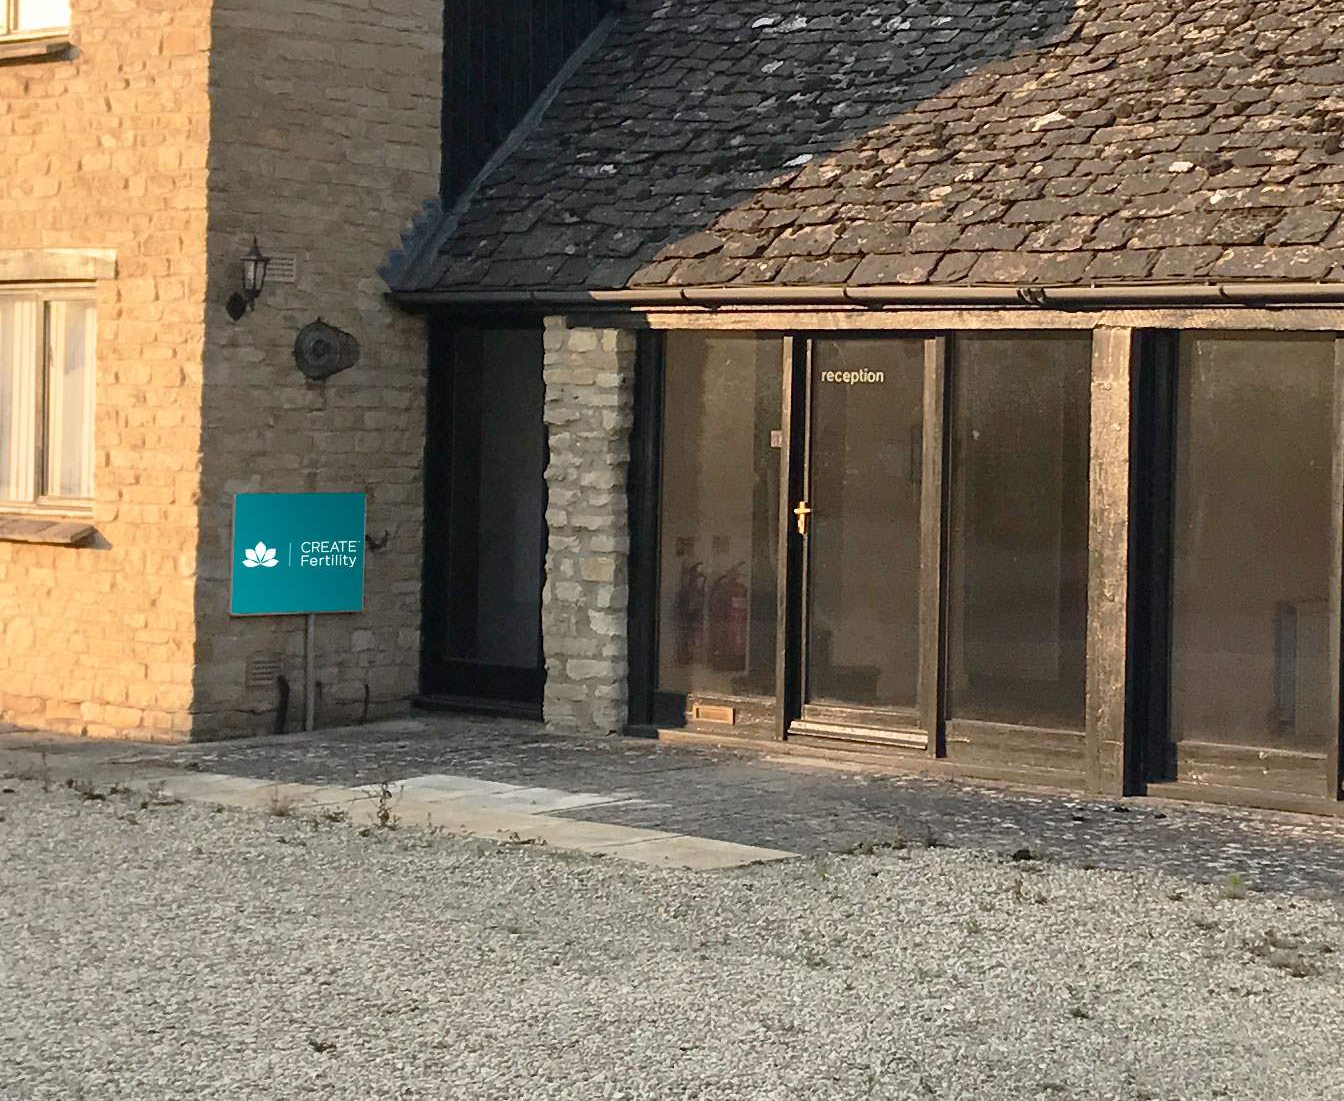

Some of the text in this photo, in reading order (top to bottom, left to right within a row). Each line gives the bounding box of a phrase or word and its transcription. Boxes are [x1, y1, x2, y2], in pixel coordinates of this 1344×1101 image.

[821, 368, 884, 385] reception
[300, 540, 357, 553] CREATE
[300, 554, 357, 568] Fertility
